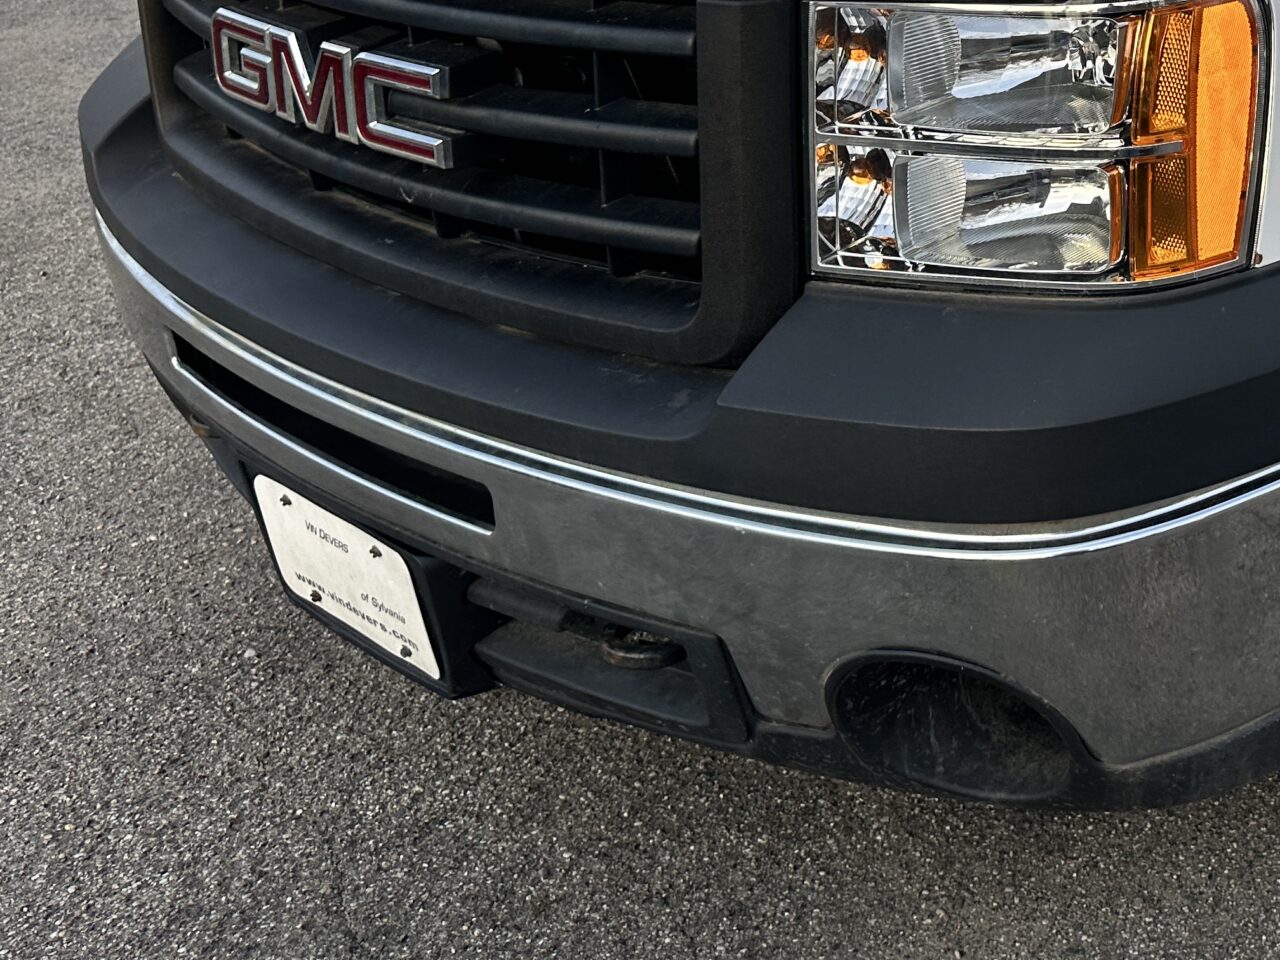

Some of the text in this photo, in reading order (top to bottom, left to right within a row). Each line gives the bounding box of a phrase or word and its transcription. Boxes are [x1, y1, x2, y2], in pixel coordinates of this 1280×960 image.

[212, 7, 453, 169] GMC
[305, 520, 349, 554] VIN DEVERS
[295, 571, 420, 653] www.vindevers.com
[360, 592, 407, 625] of Sylvania
